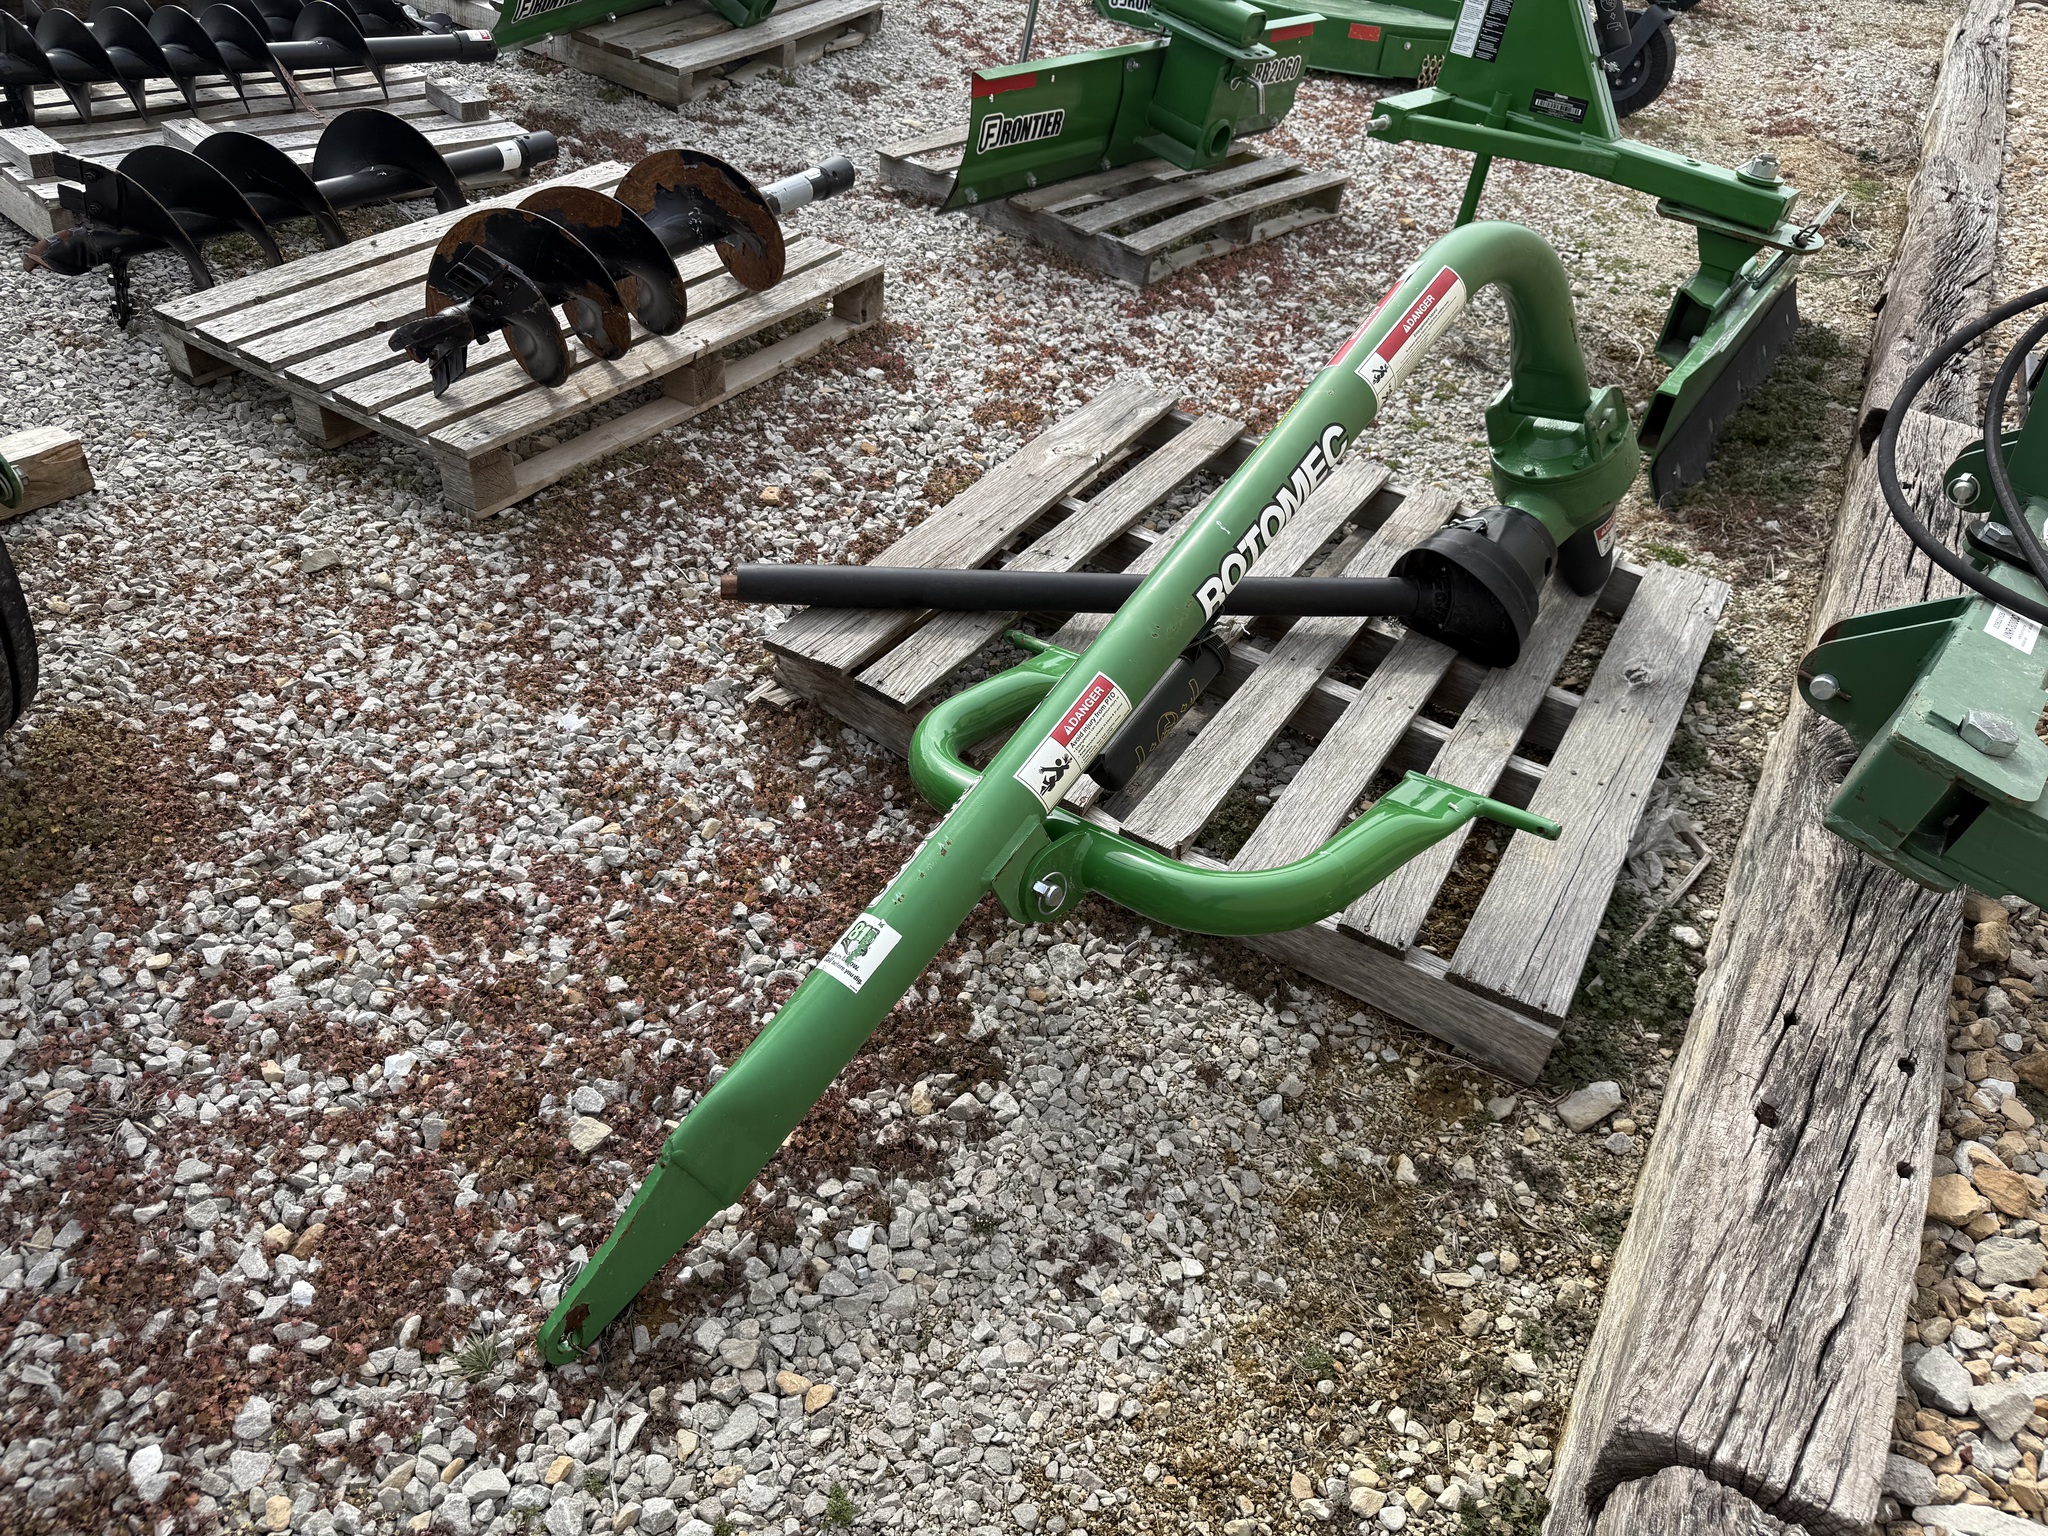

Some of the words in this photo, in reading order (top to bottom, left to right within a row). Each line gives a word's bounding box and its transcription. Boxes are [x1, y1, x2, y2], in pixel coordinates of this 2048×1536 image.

[978, 109, 1064, 154] FRONTIER
[1405, 293, 1436, 327] DANGER
[1193, 423, 1348, 623] ROTOMEC
[1067, 685, 1105, 727] DANGER
[1069, 731, 1084, 748] Avoid
[1081, 715, 1097, 733] injury
[1093, 703, 1107, 717] from
[1103, 691, 1116, 705] PTO
[844, 968, 854, 978] you
